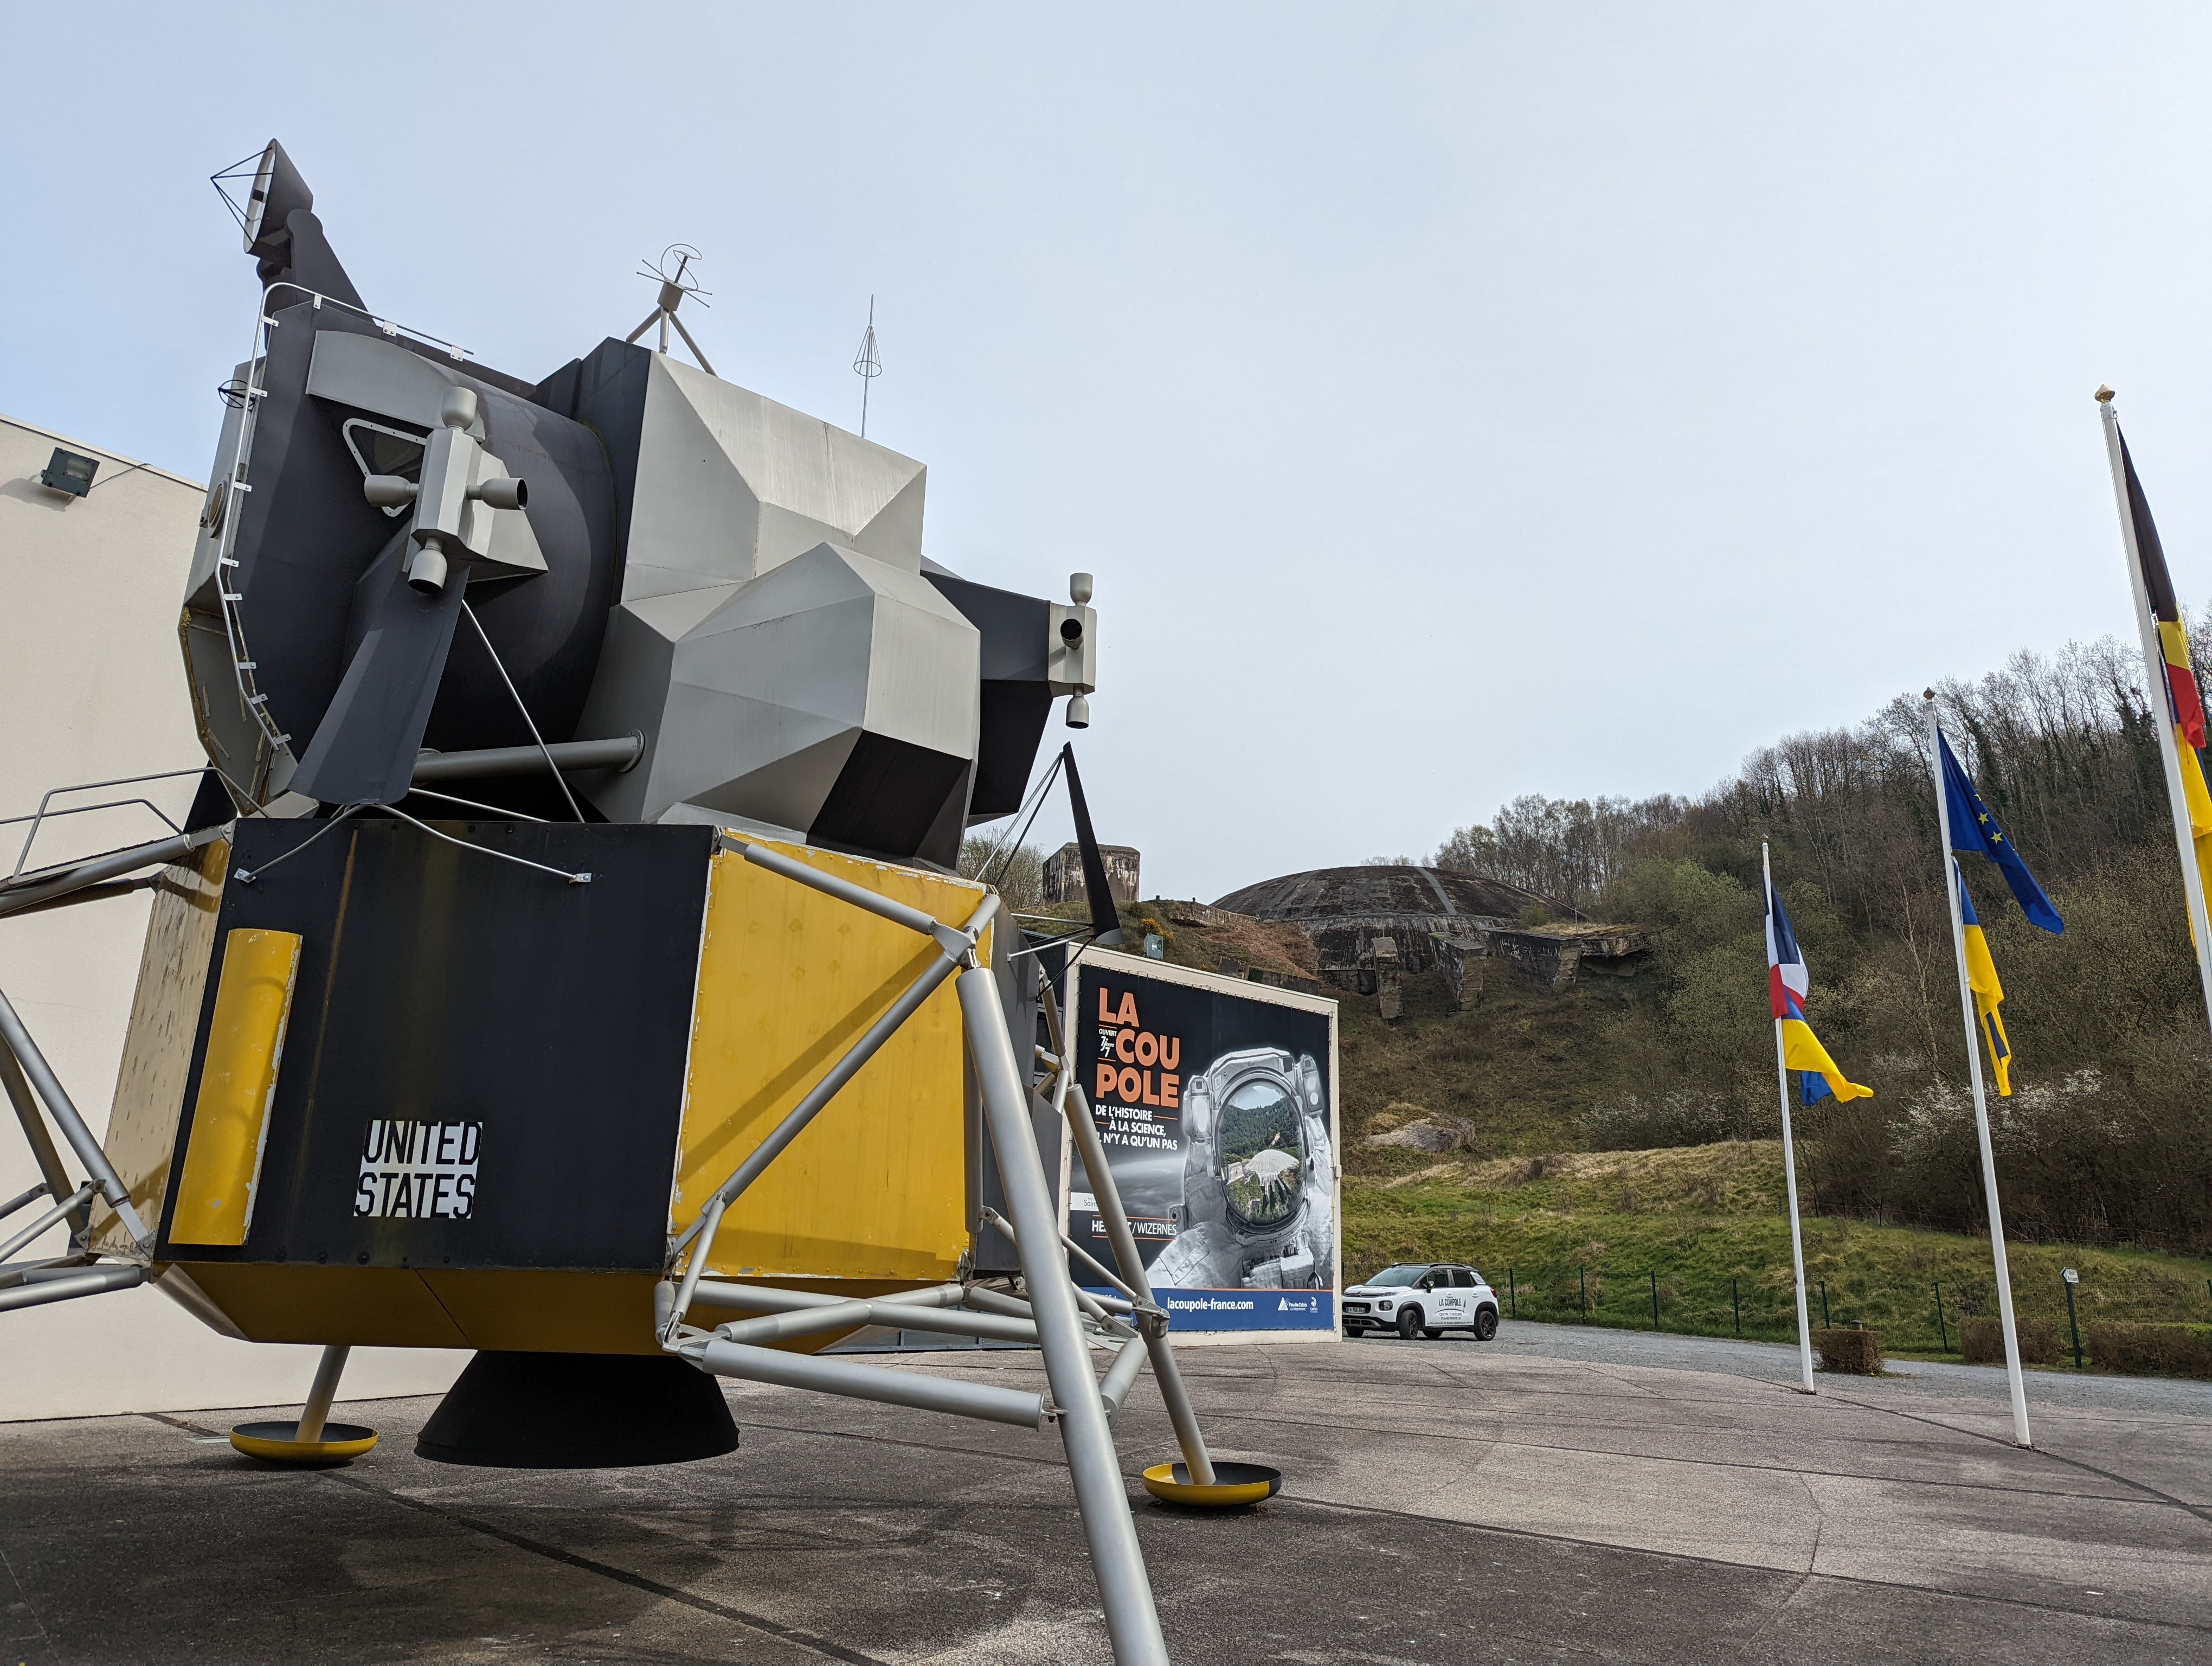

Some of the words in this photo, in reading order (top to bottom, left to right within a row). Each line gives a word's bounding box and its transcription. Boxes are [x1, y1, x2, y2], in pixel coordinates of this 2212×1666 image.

[1099, 987, 1140, 1027] LA
[1099, 1028, 1117, 1036] OUVERT
[1116, 1028, 1179, 1070] COU
[1096, 1063, 1179, 1108] POLE
[1095, 1104, 1107, 1116] DE
[1109, 1106, 1153, 1121] L'HISTOIRE
[1109, 1117, 1116, 1131] À
[1118, 1120, 1129, 1132] LA
[1131, 1122, 1166, 1137] SCIENCE,
[363, 1120, 482, 1165] UNITED
[1103, 1132, 1121, 1144] N'Y
[1121, 1135, 1129, 1145] A
[1130, 1136, 1160, 1149] QU'UN
[1162, 1139, 1178, 1150] PAS
[355, 1172, 475, 1219] STATES
[1167, 1297, 1254, 1312] lacoupole-france.com
[1438, 1298, 1444, 1306] LA
[1444, 1298, 1462, 1306] COUPOLE
